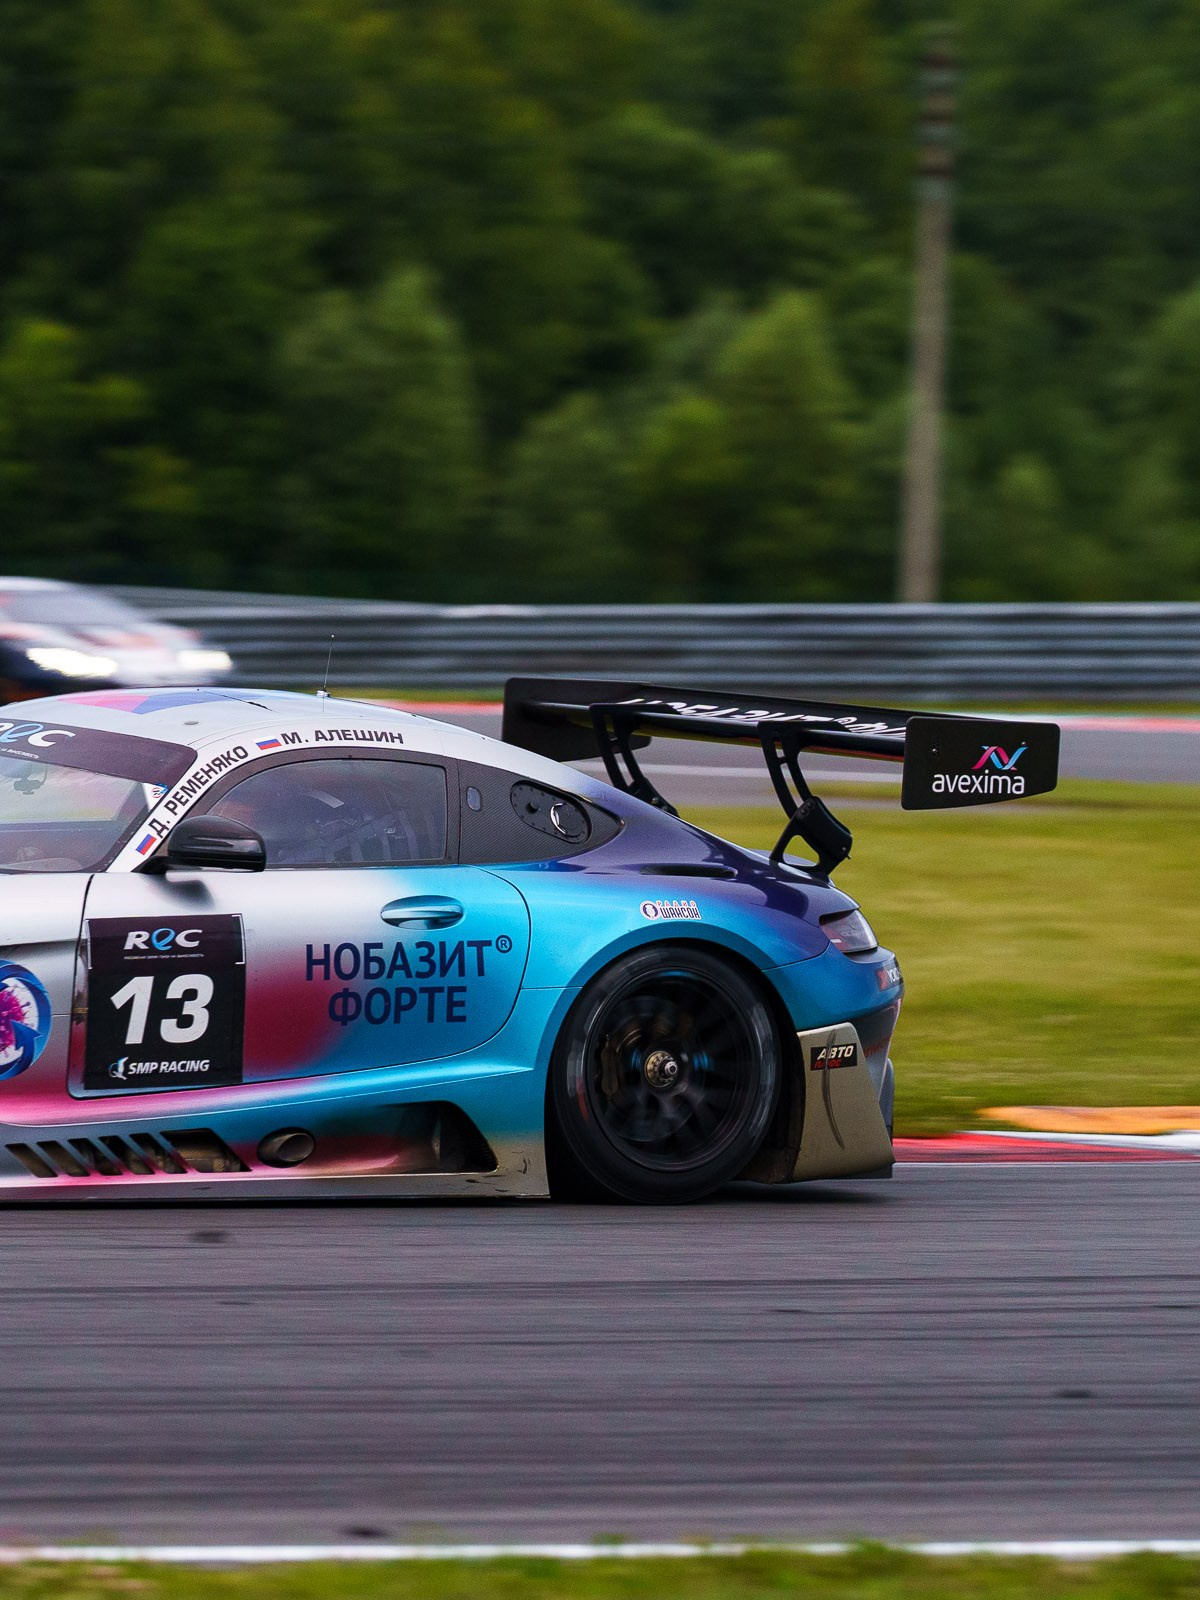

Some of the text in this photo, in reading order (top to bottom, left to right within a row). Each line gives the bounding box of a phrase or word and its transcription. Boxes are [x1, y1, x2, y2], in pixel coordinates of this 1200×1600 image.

[314, 728, 405, 745] АЛЕШИН
[147, 745, 249, 839] Д. РЕМЕНЯКО
[931, 769, 1026, 795] avexima
[110, 973, 215, 1045] 13
[328, 985, 468, 1026] ФОРТЕ
[817, 1045, 854, 1061] АВТО
[127, 1059, 211, 1075] SMP RACING
